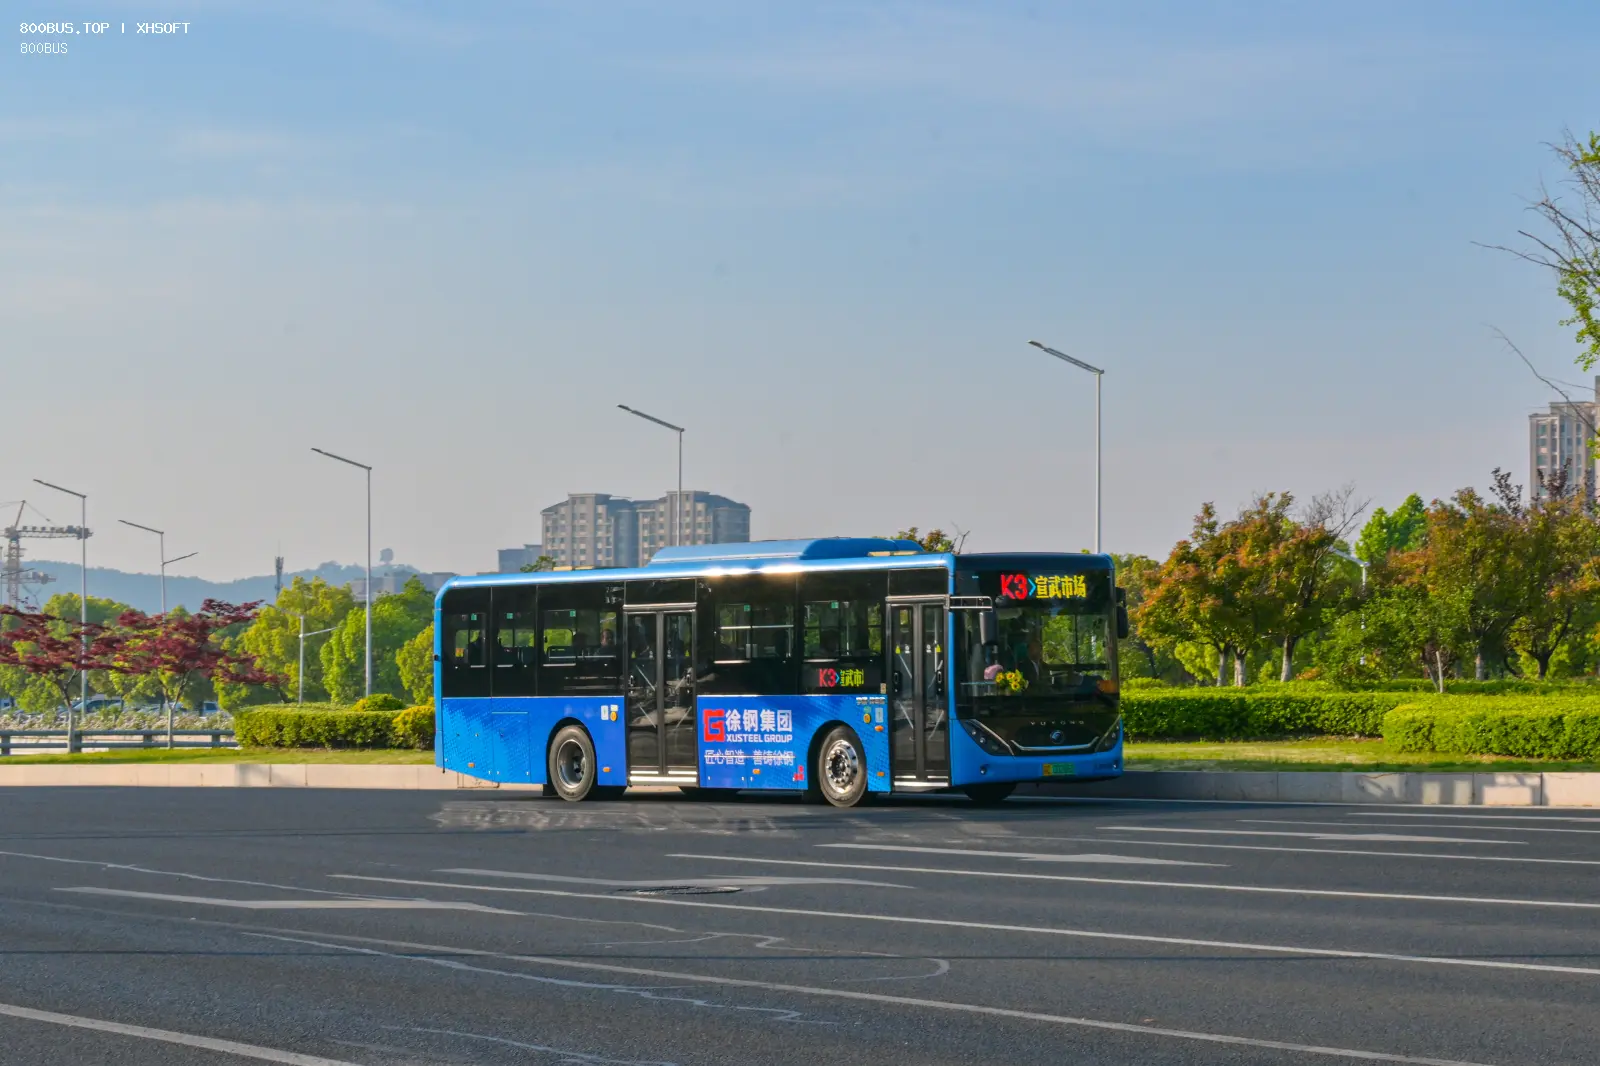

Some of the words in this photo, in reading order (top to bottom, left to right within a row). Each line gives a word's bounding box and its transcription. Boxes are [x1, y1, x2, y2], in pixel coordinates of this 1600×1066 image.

[1000, 574, 1028, 600] K3
[1035, 575, 1086, 599] 宣武市场
[819, 668, 837, 687] K3
[725, 709, 793, 732] 徐钢集团
[726, 733, 763, 743] XUSTEEL
[764, 734, 793, 743] GROUP
[704, 749, 745, 765] 匠心智造
